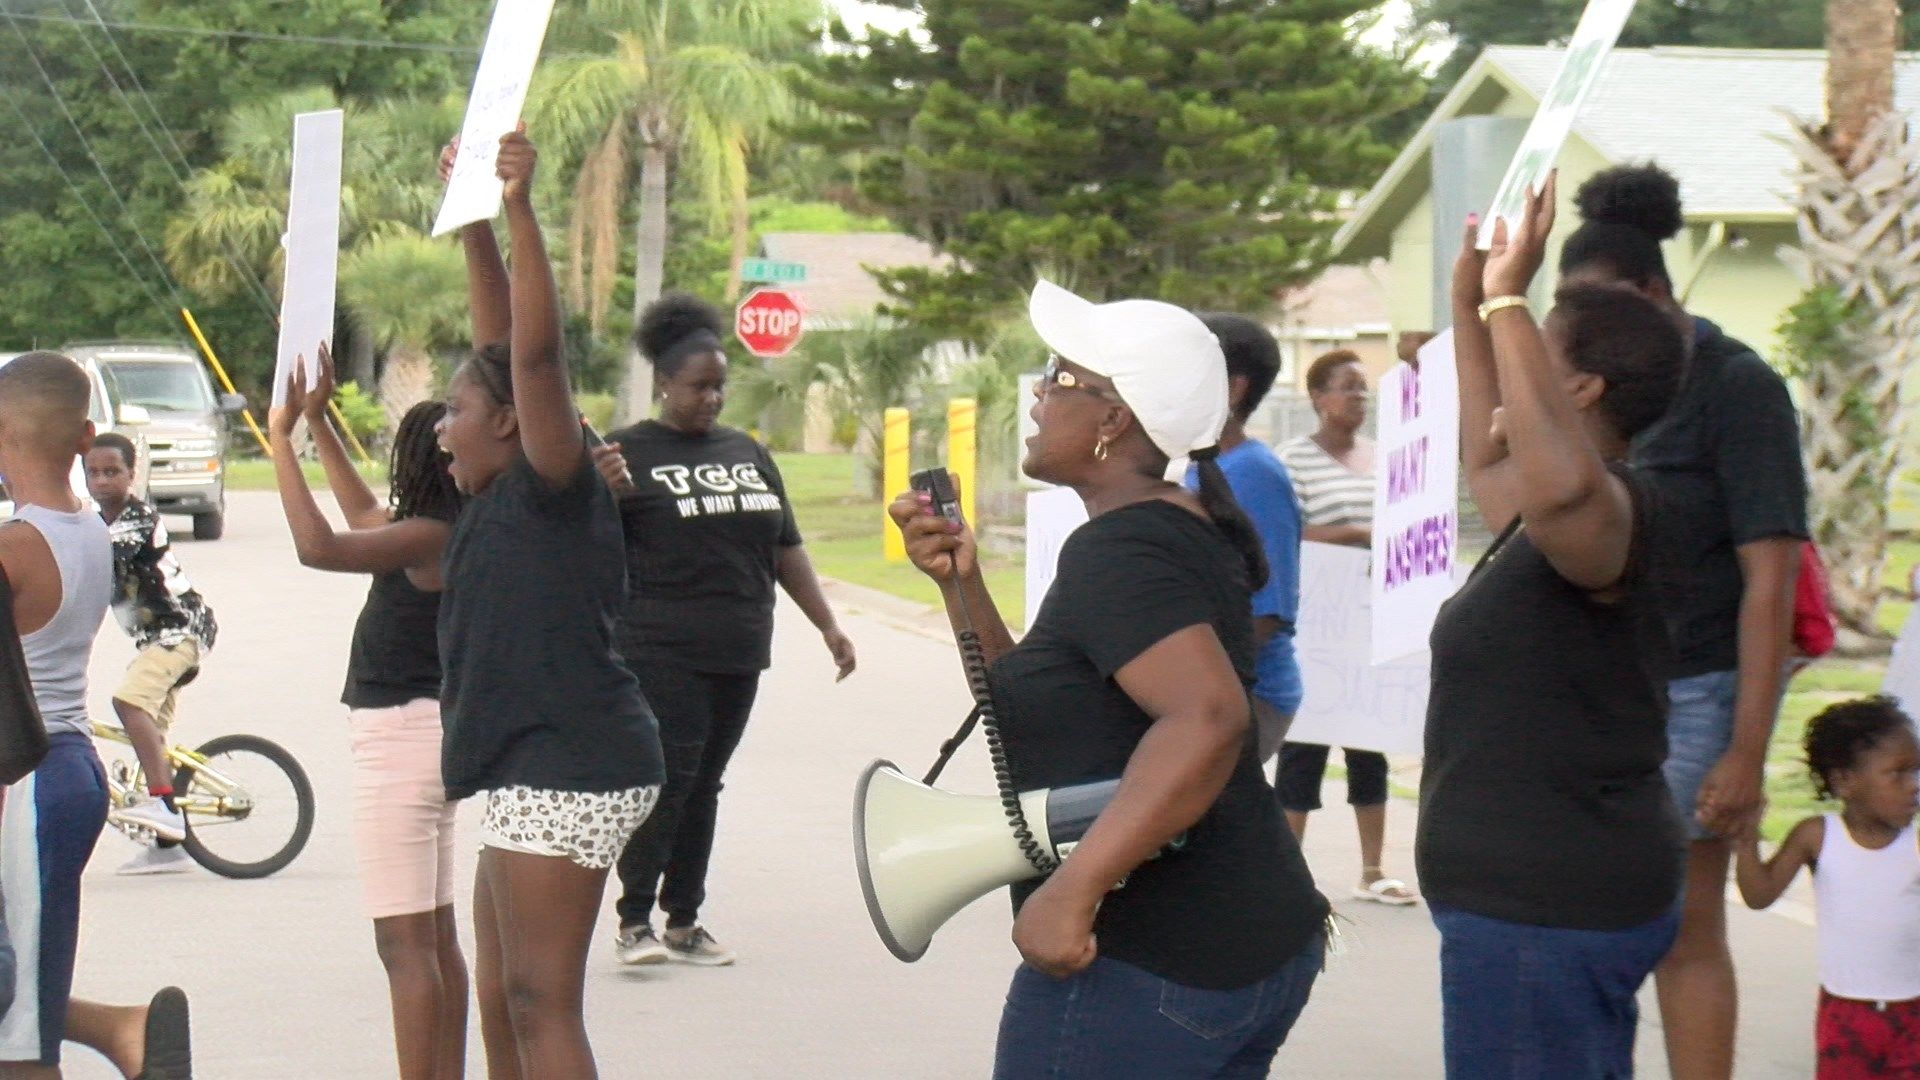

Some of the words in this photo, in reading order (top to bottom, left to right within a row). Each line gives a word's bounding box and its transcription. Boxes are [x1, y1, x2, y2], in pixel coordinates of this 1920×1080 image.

[741, 307, 799, 336] STOP
[1401, 362, 1421, 424] WE
[651, 463, 768, 495] TCC
[1387, 435, 1428, 505] WANT
[677, 497, 699, 518] WE
[701, 494, 736, 515] WANT
